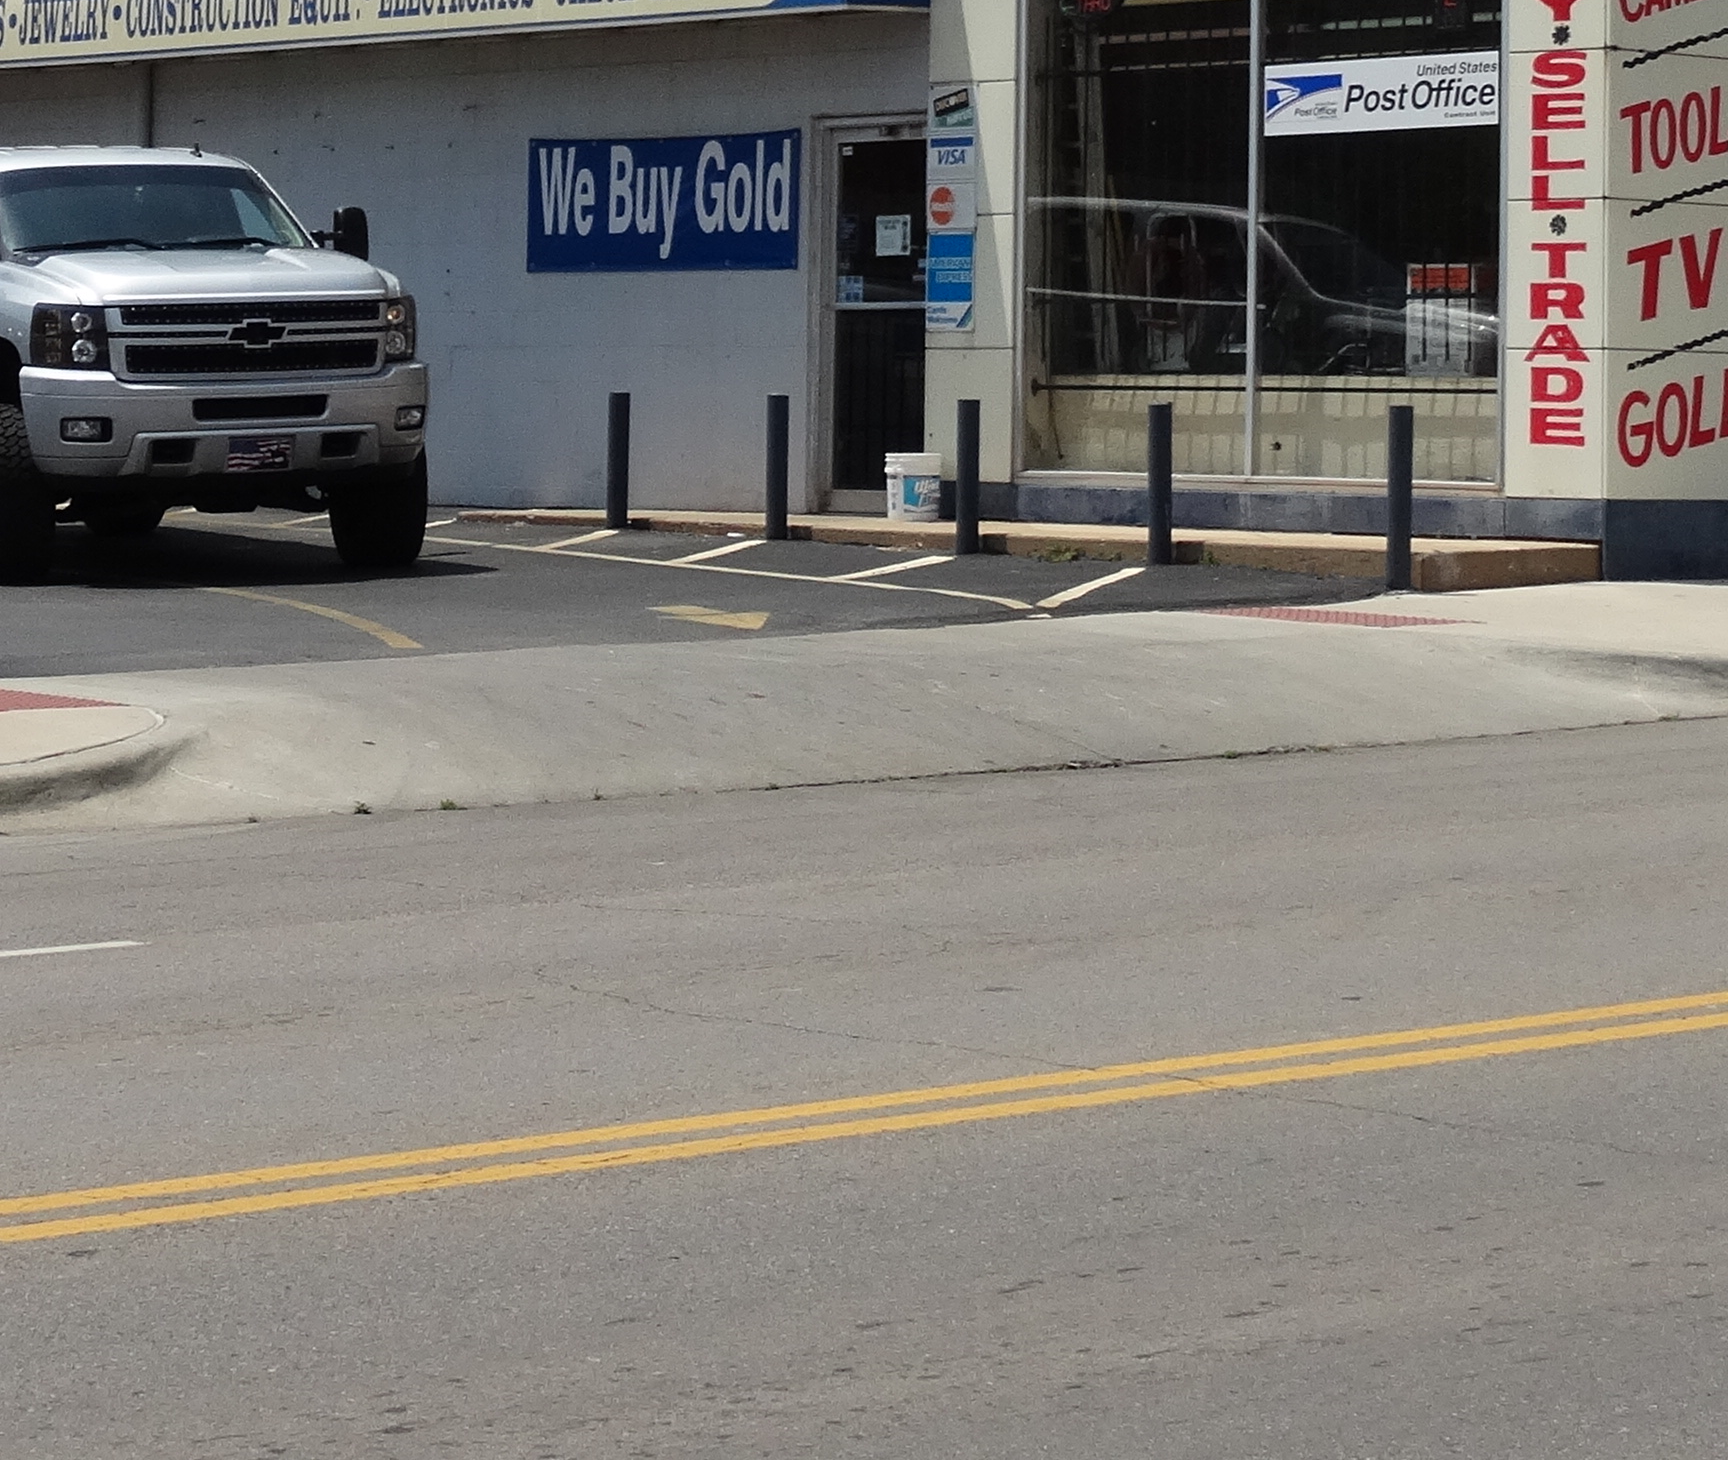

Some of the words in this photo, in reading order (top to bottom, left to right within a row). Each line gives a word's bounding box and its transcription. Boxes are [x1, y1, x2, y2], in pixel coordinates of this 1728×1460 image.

[1344, 83, 1408, 113] Post
[1411, 78, 1495, 110] Office
[1416, 62, 1456, 77] United
[1458, 61, 1497, 74] States
[937, 149, 966, 165] VISA
[1530, 50, 1587, 211] SELL
[538, 145, 596, 237] We
[608, 144, 681, 260] Buy
[694, 139, 792, 234] Gold
[1523, 242, 1591, 447] TRADE
